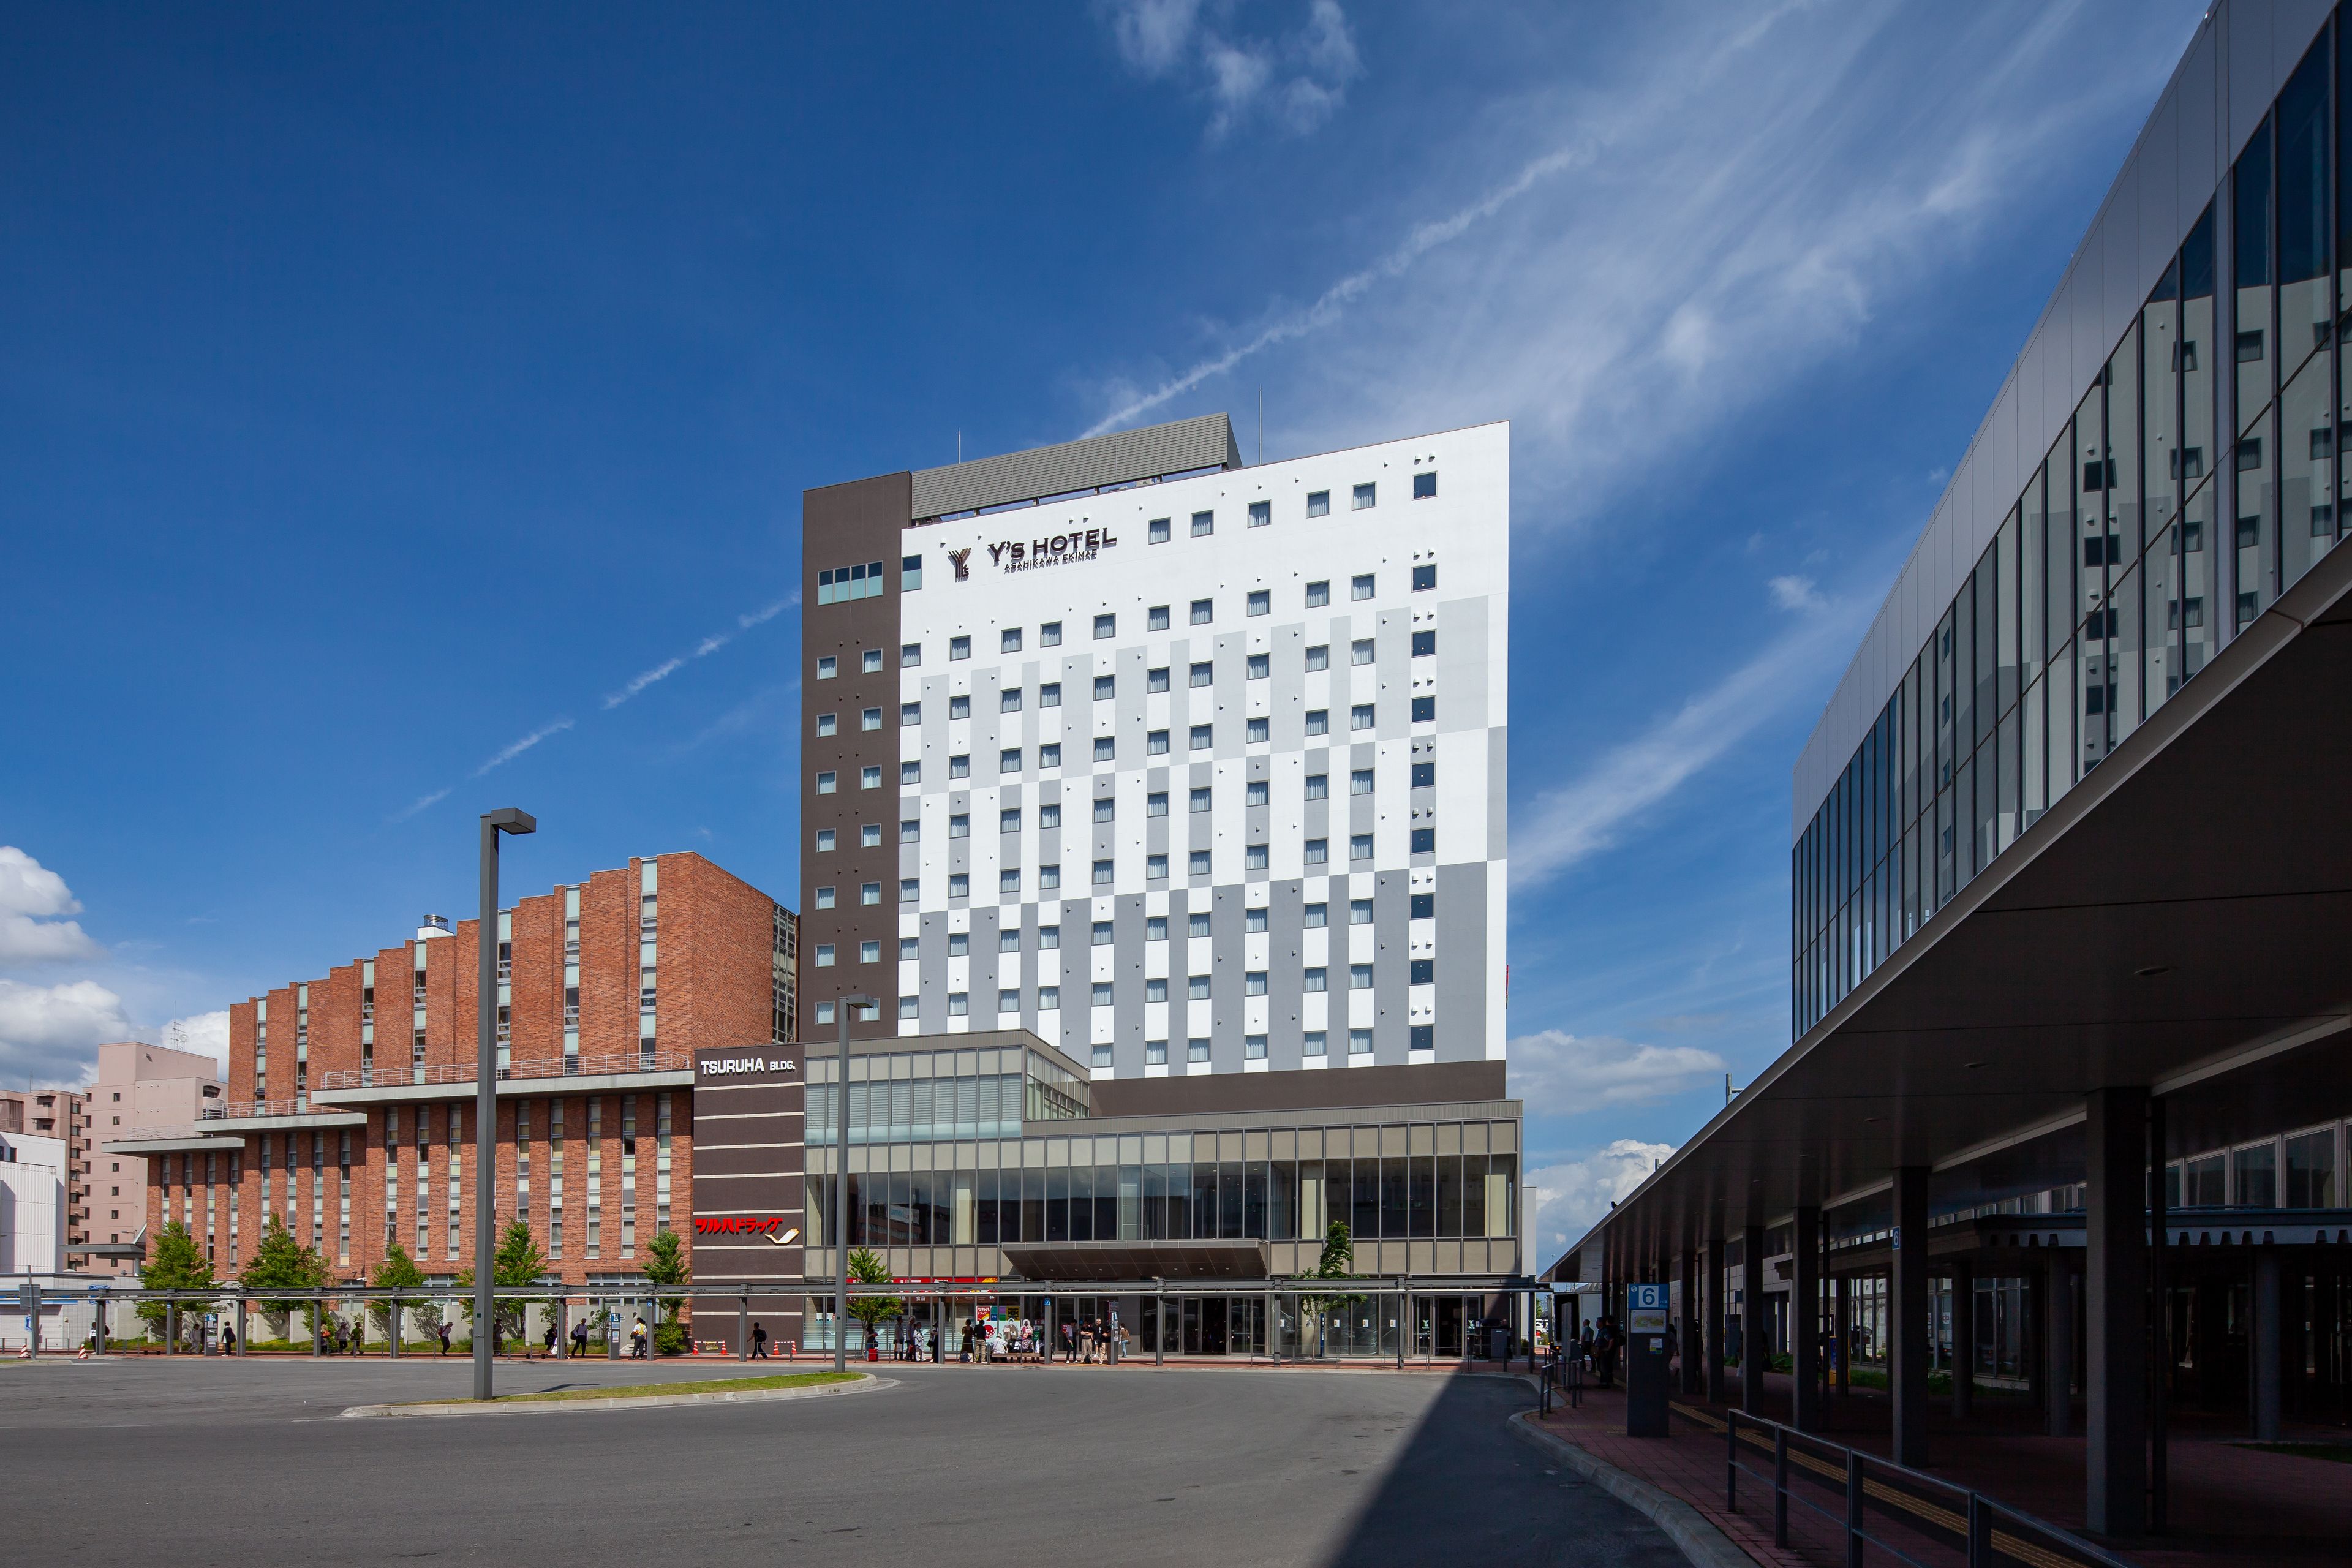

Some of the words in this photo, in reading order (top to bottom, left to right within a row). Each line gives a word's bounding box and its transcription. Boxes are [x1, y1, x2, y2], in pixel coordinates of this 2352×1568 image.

[1033, 527, 1117, 556] HOTEL
[1005, 556, 1060, 571] ASAHIKAWA
[1063, 549, 1098, 561] EKIMAE
[700, 1058, 765, 1075] TSURUHA
[769, 1060, 796, 1071] BLDG.
[695, 1217, 783, 1234] ツルハドラッグ
[1893, 1231, 1899, 1246] 6
[1642, 1287, 1656, 1305] 6
